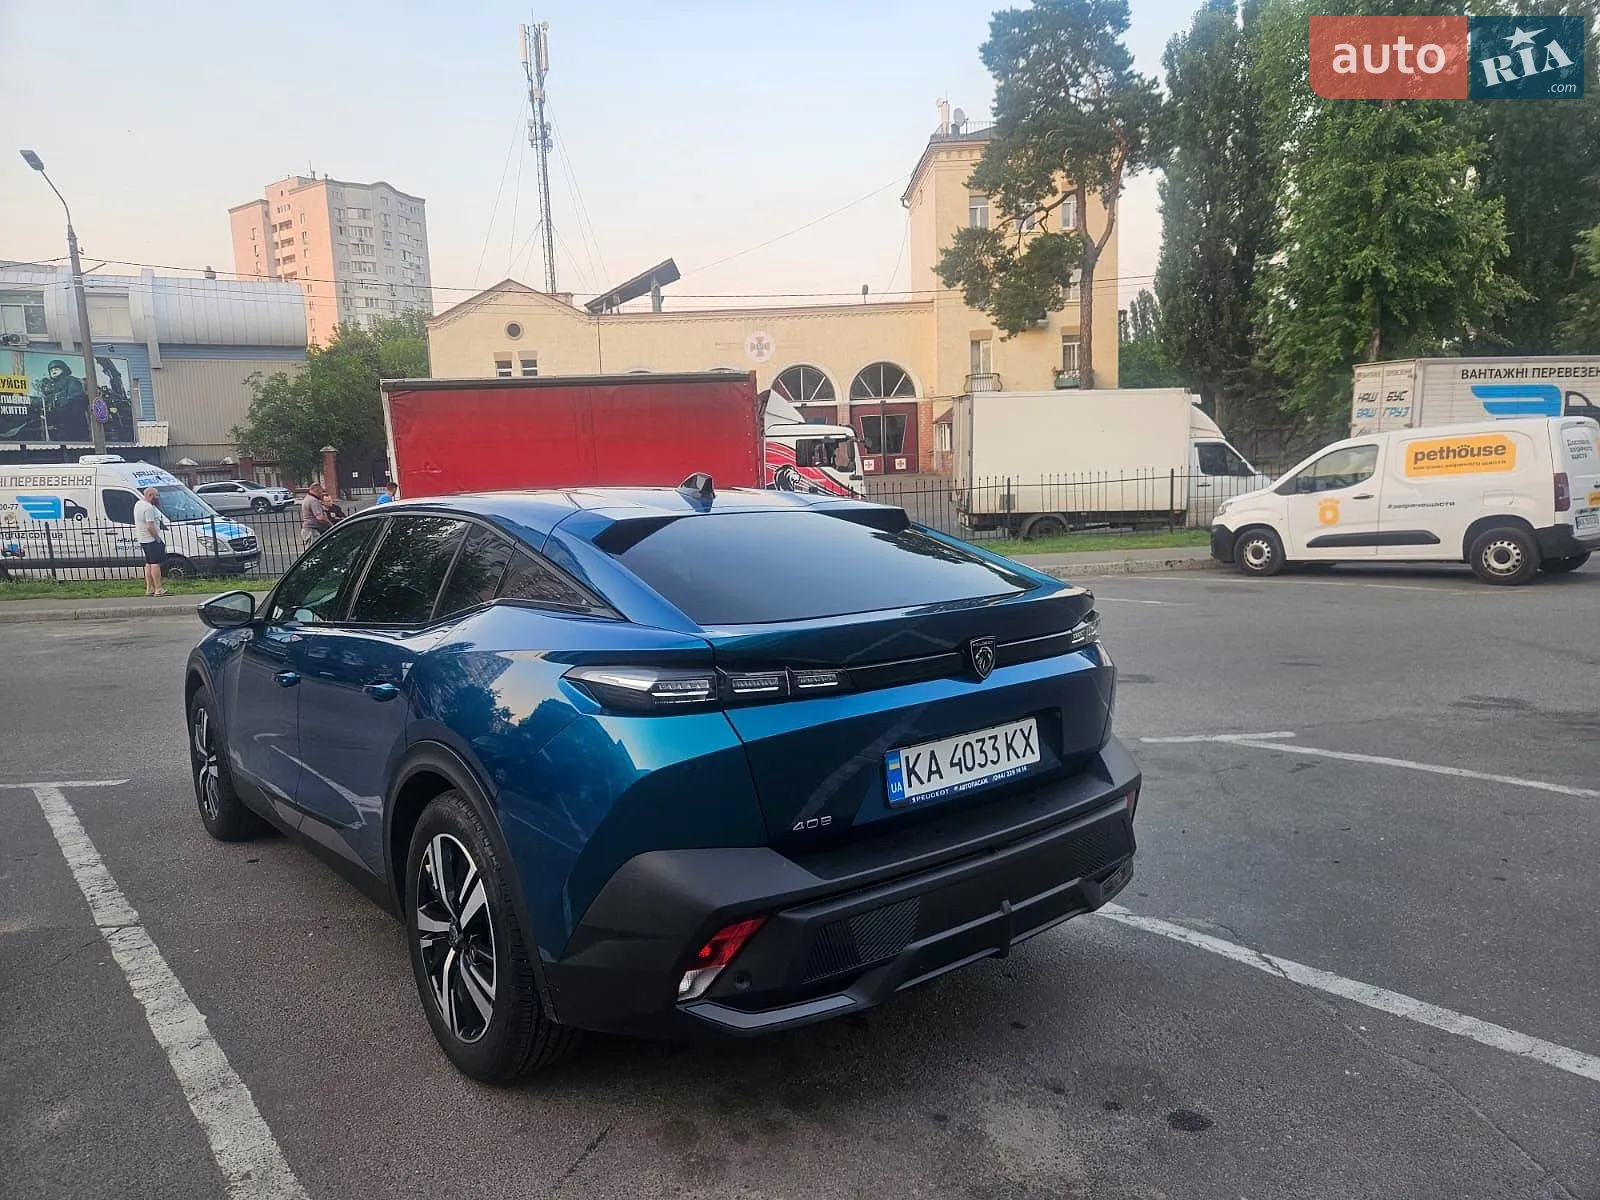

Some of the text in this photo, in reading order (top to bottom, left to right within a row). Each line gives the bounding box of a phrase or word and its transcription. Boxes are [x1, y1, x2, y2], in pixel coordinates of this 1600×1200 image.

[1461, 367, 1528, 380] ВАНТАЖНІ
[10, 476, 92, 487] ПЕРЕВЕЗЕННЯ
[904, 725, 1035, 788] KA 4033 KX
[890, 782, 903, 794] UA
[916, 789, 949, 802] PEUGEOT
[792, 815, 832, 831] 408
